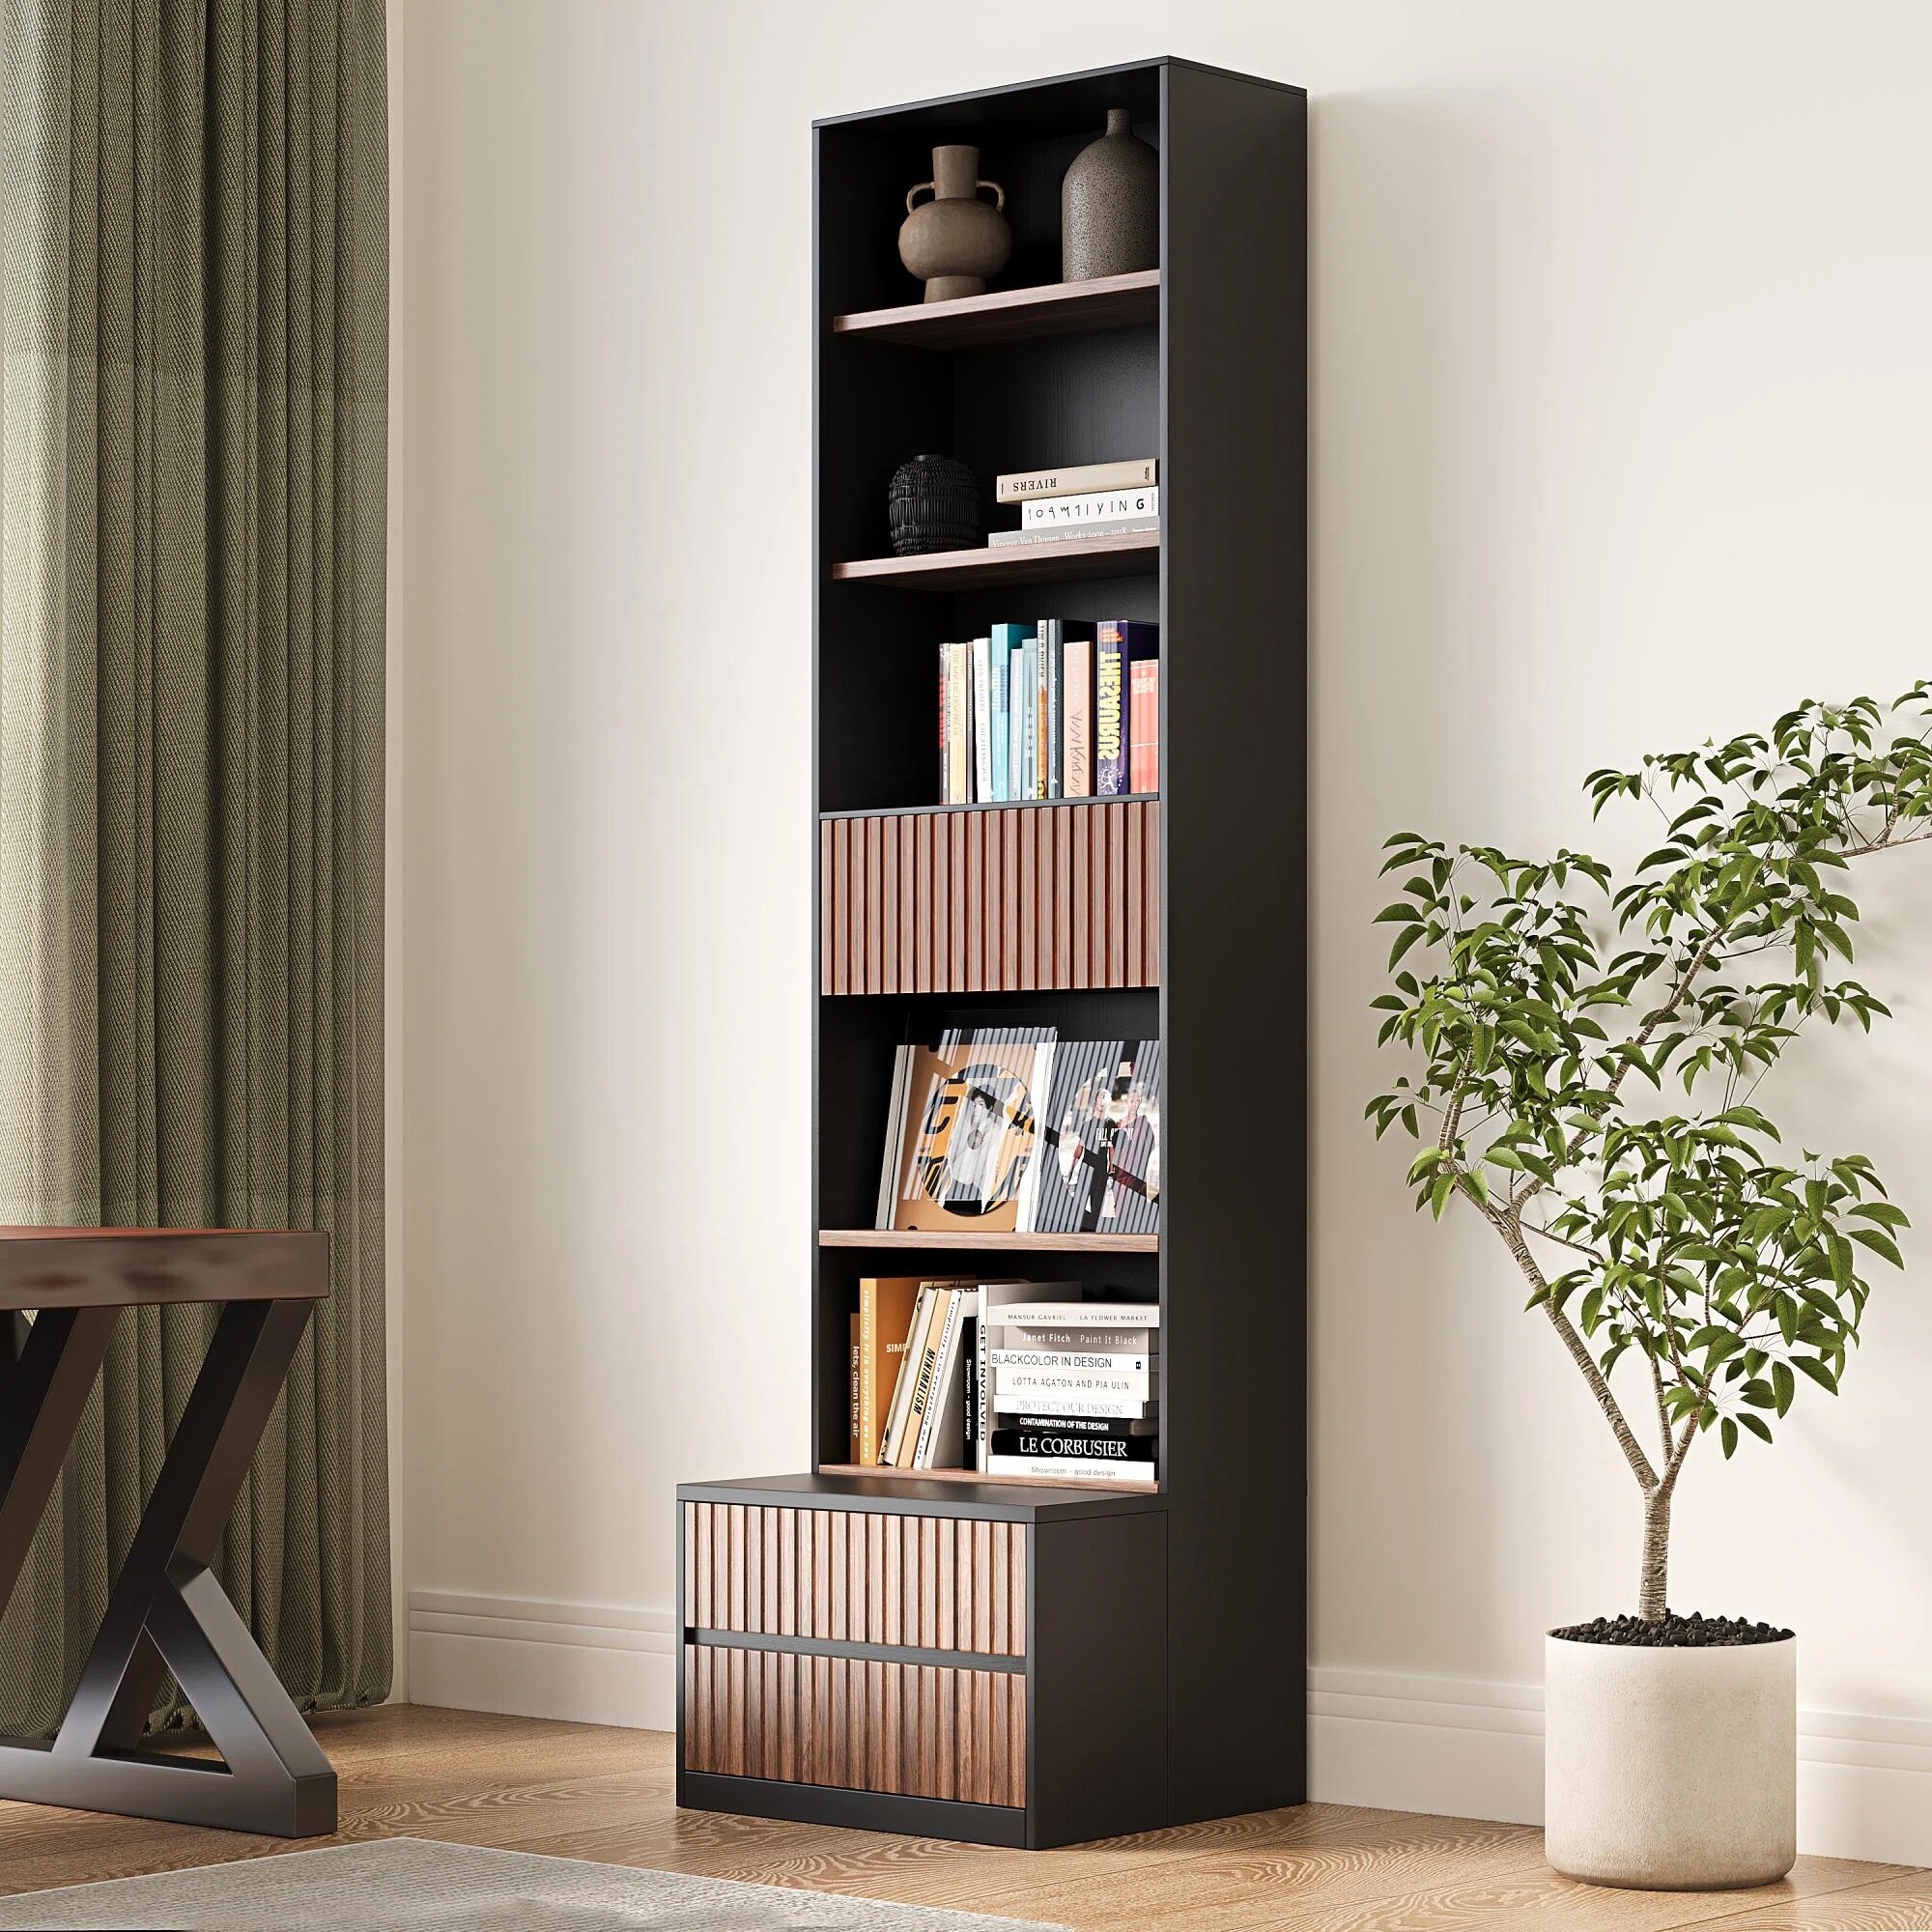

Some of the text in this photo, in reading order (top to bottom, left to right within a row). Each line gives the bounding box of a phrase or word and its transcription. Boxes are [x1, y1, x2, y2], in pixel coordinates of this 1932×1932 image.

[1012, 477, 1057, 492] RIVERS
[1064, 530, 1087, 540] Works
[1022, 1332, 1070, 1343] Janet Fitch
[1080, 1334, 1137, 1345] Paint It Black
[991, 1353, 1112, 1368] BLACKCOLOR IN DESIGN
[914, 1348, 935, 1415] MINIMALISM
[1012, 1377, 1129, 1390] LOTTA AGATON AND PIA ULIN
[1019, 1417, 1109, 1431] CONTAMINATION OF THE DESIGN
[1019, 1436, 1128, 1457] LE CORBUSIER
